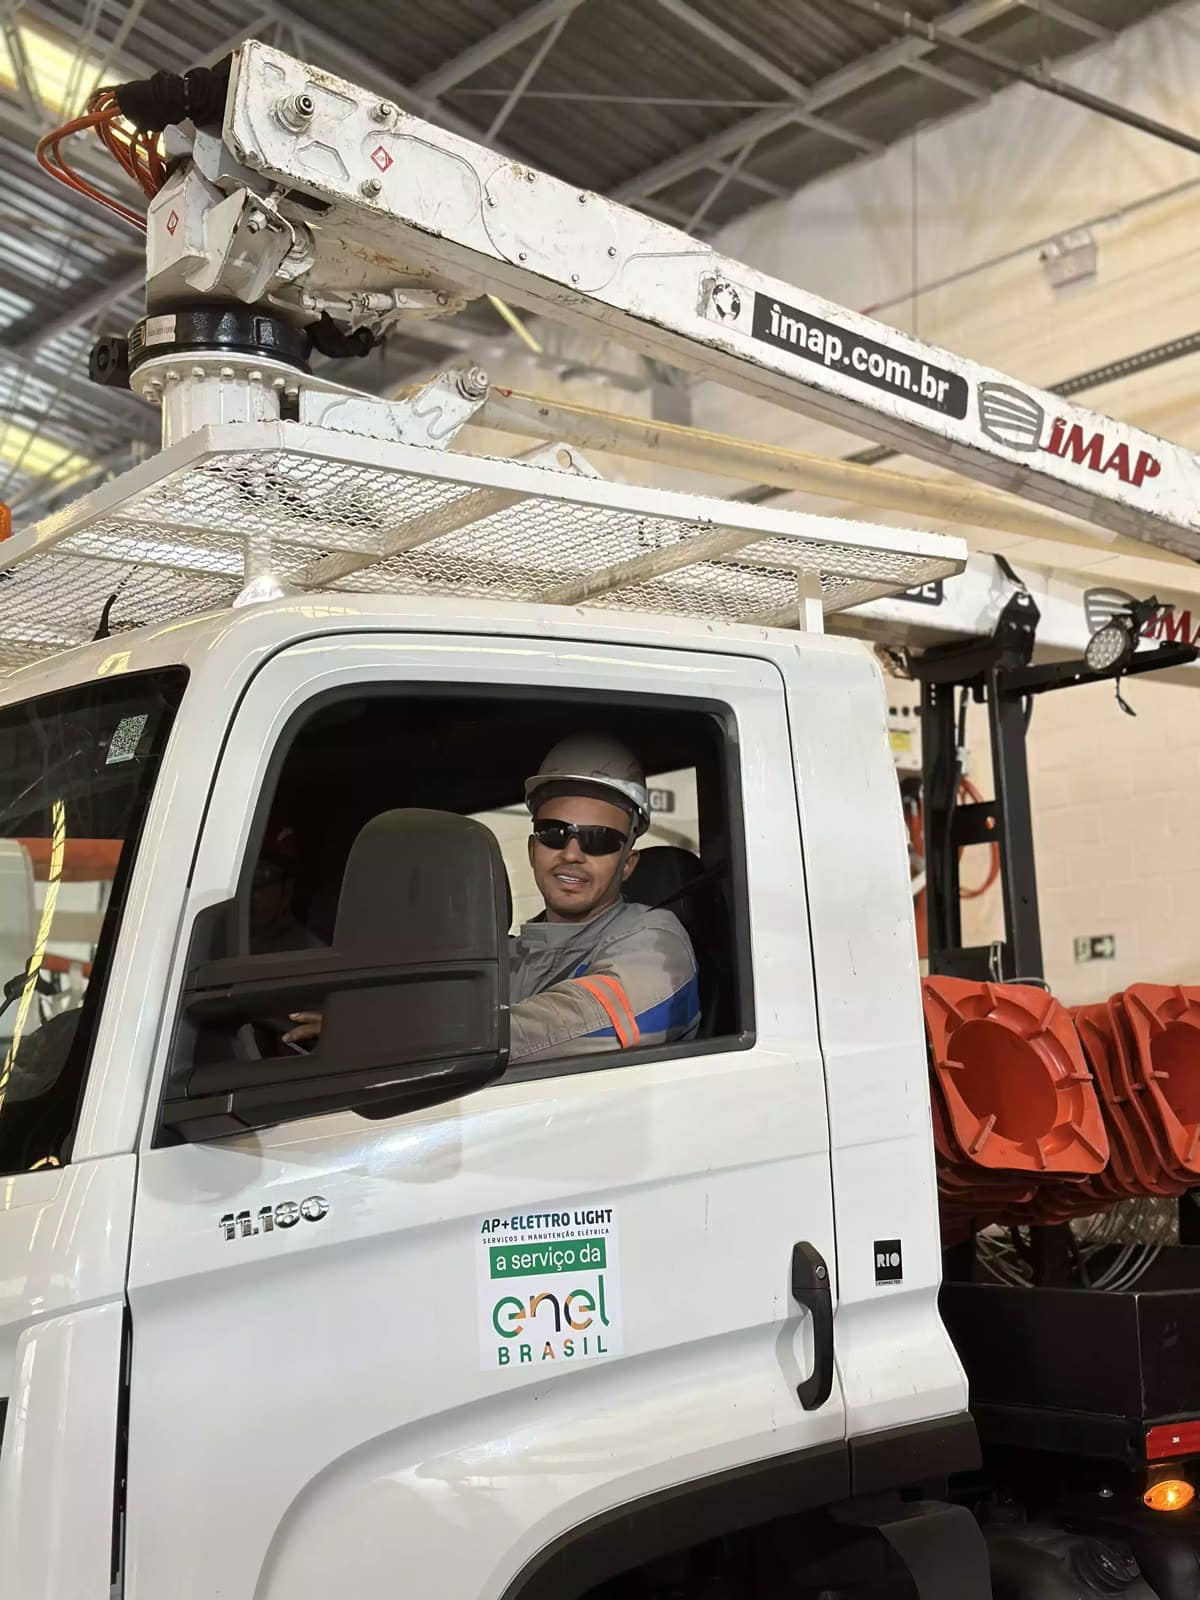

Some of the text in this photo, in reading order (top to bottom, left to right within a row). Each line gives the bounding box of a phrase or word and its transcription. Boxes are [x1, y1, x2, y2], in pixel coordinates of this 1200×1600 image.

[770, 304, 949, 402] imap.com.br
[219, 1196, 329, 1240] 11.180
[481, 1209, 612, 1233] AP+ELETTRO LIGHT
[483, 1235, 518, 1245] SERVIÇOS
[528, 1229, 575, 1241] MANUTENÇÃO
[578, 1227, 609, 1238] ELÉTRICA
[496, 1243, 601, 1271] a serviço da
[876, 1252, 900, 1268] RIO
[492, 1275, 610, 1338] enel
[498, 1336, 608, 1365] BRASIL
